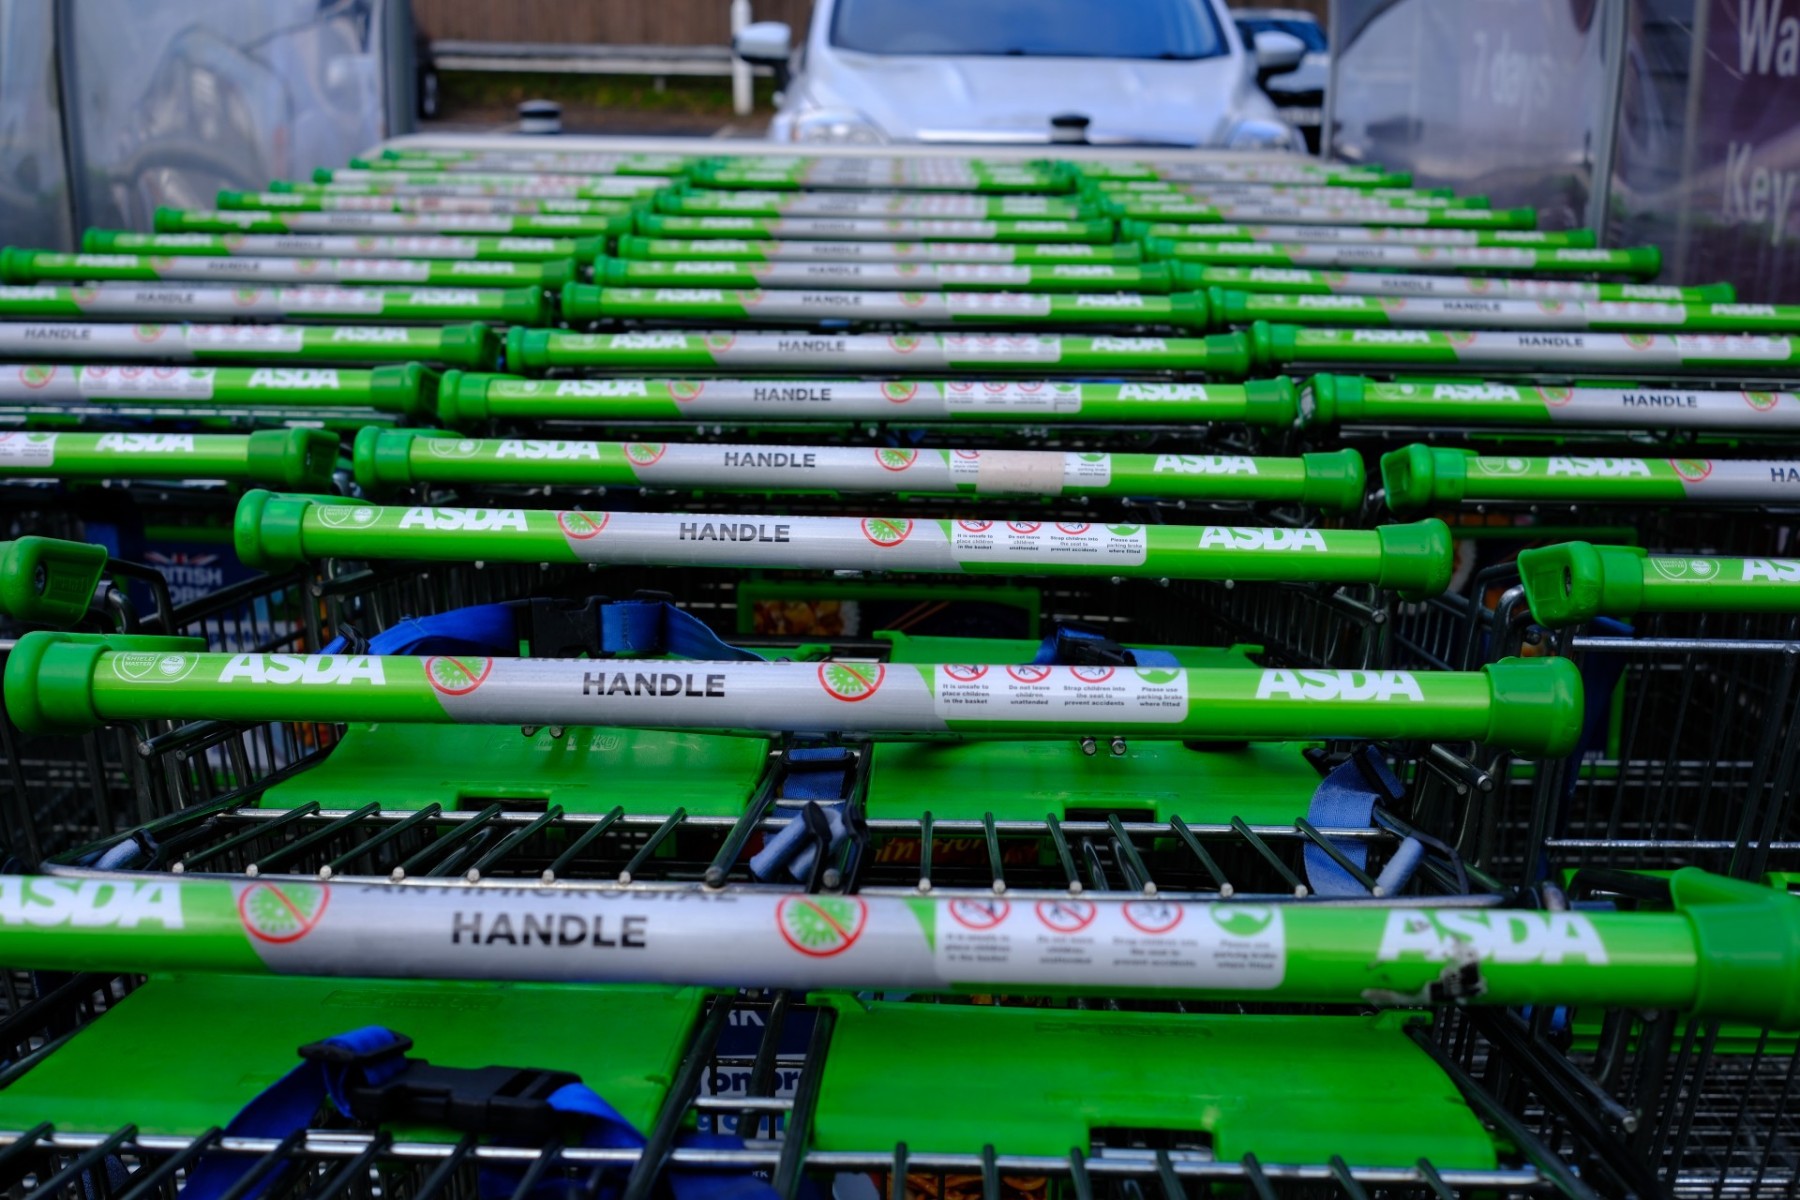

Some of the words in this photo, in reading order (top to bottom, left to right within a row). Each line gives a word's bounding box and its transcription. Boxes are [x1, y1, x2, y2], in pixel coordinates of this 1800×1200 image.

[1722, 140, 1798, 247] Key
[24, 328, 91, 341] HANDLE
[609, 334, 688, 349] ASDA
[1354, 330, 1430, 344] ASDA
[1518, 335, 1584, 347] HANDLE
[778, 340, 846, 353] HANDLE
[1090, 337, 1168, 352] ASDA
[248, 369, 341, 388] ASDA
[554, 381, 647, 398] ASDA
[754, 387, 832, 402] HANDLE
[1118, 383, 1209, 401] ASDA
[1433, 385, 1520, 402] ASDA
[1622, 394, 1698, 408] HANDLE
[95, 433, 195, 453] ASDA
[495, 440, 600, 460] ASDA
[725, 452, 816, 468] HANDLE
[1153, 454, 1259, 475] ASDA
[1546, 456, 1652, 477] ASDA
[397, 506, 528, 531] ASDA
[681, 523, 790, 543] HANDLE
[1199, 526, 1328, 551] ASDA
[219, 653, 387, 685] ASDA
[582, 672, 725, 698] HANDLE
[1255, 668, 1426, 704] ASDA
[452, 912, 646, 948] HANDLE
[1378, 908, 1609, 965] ASDA
